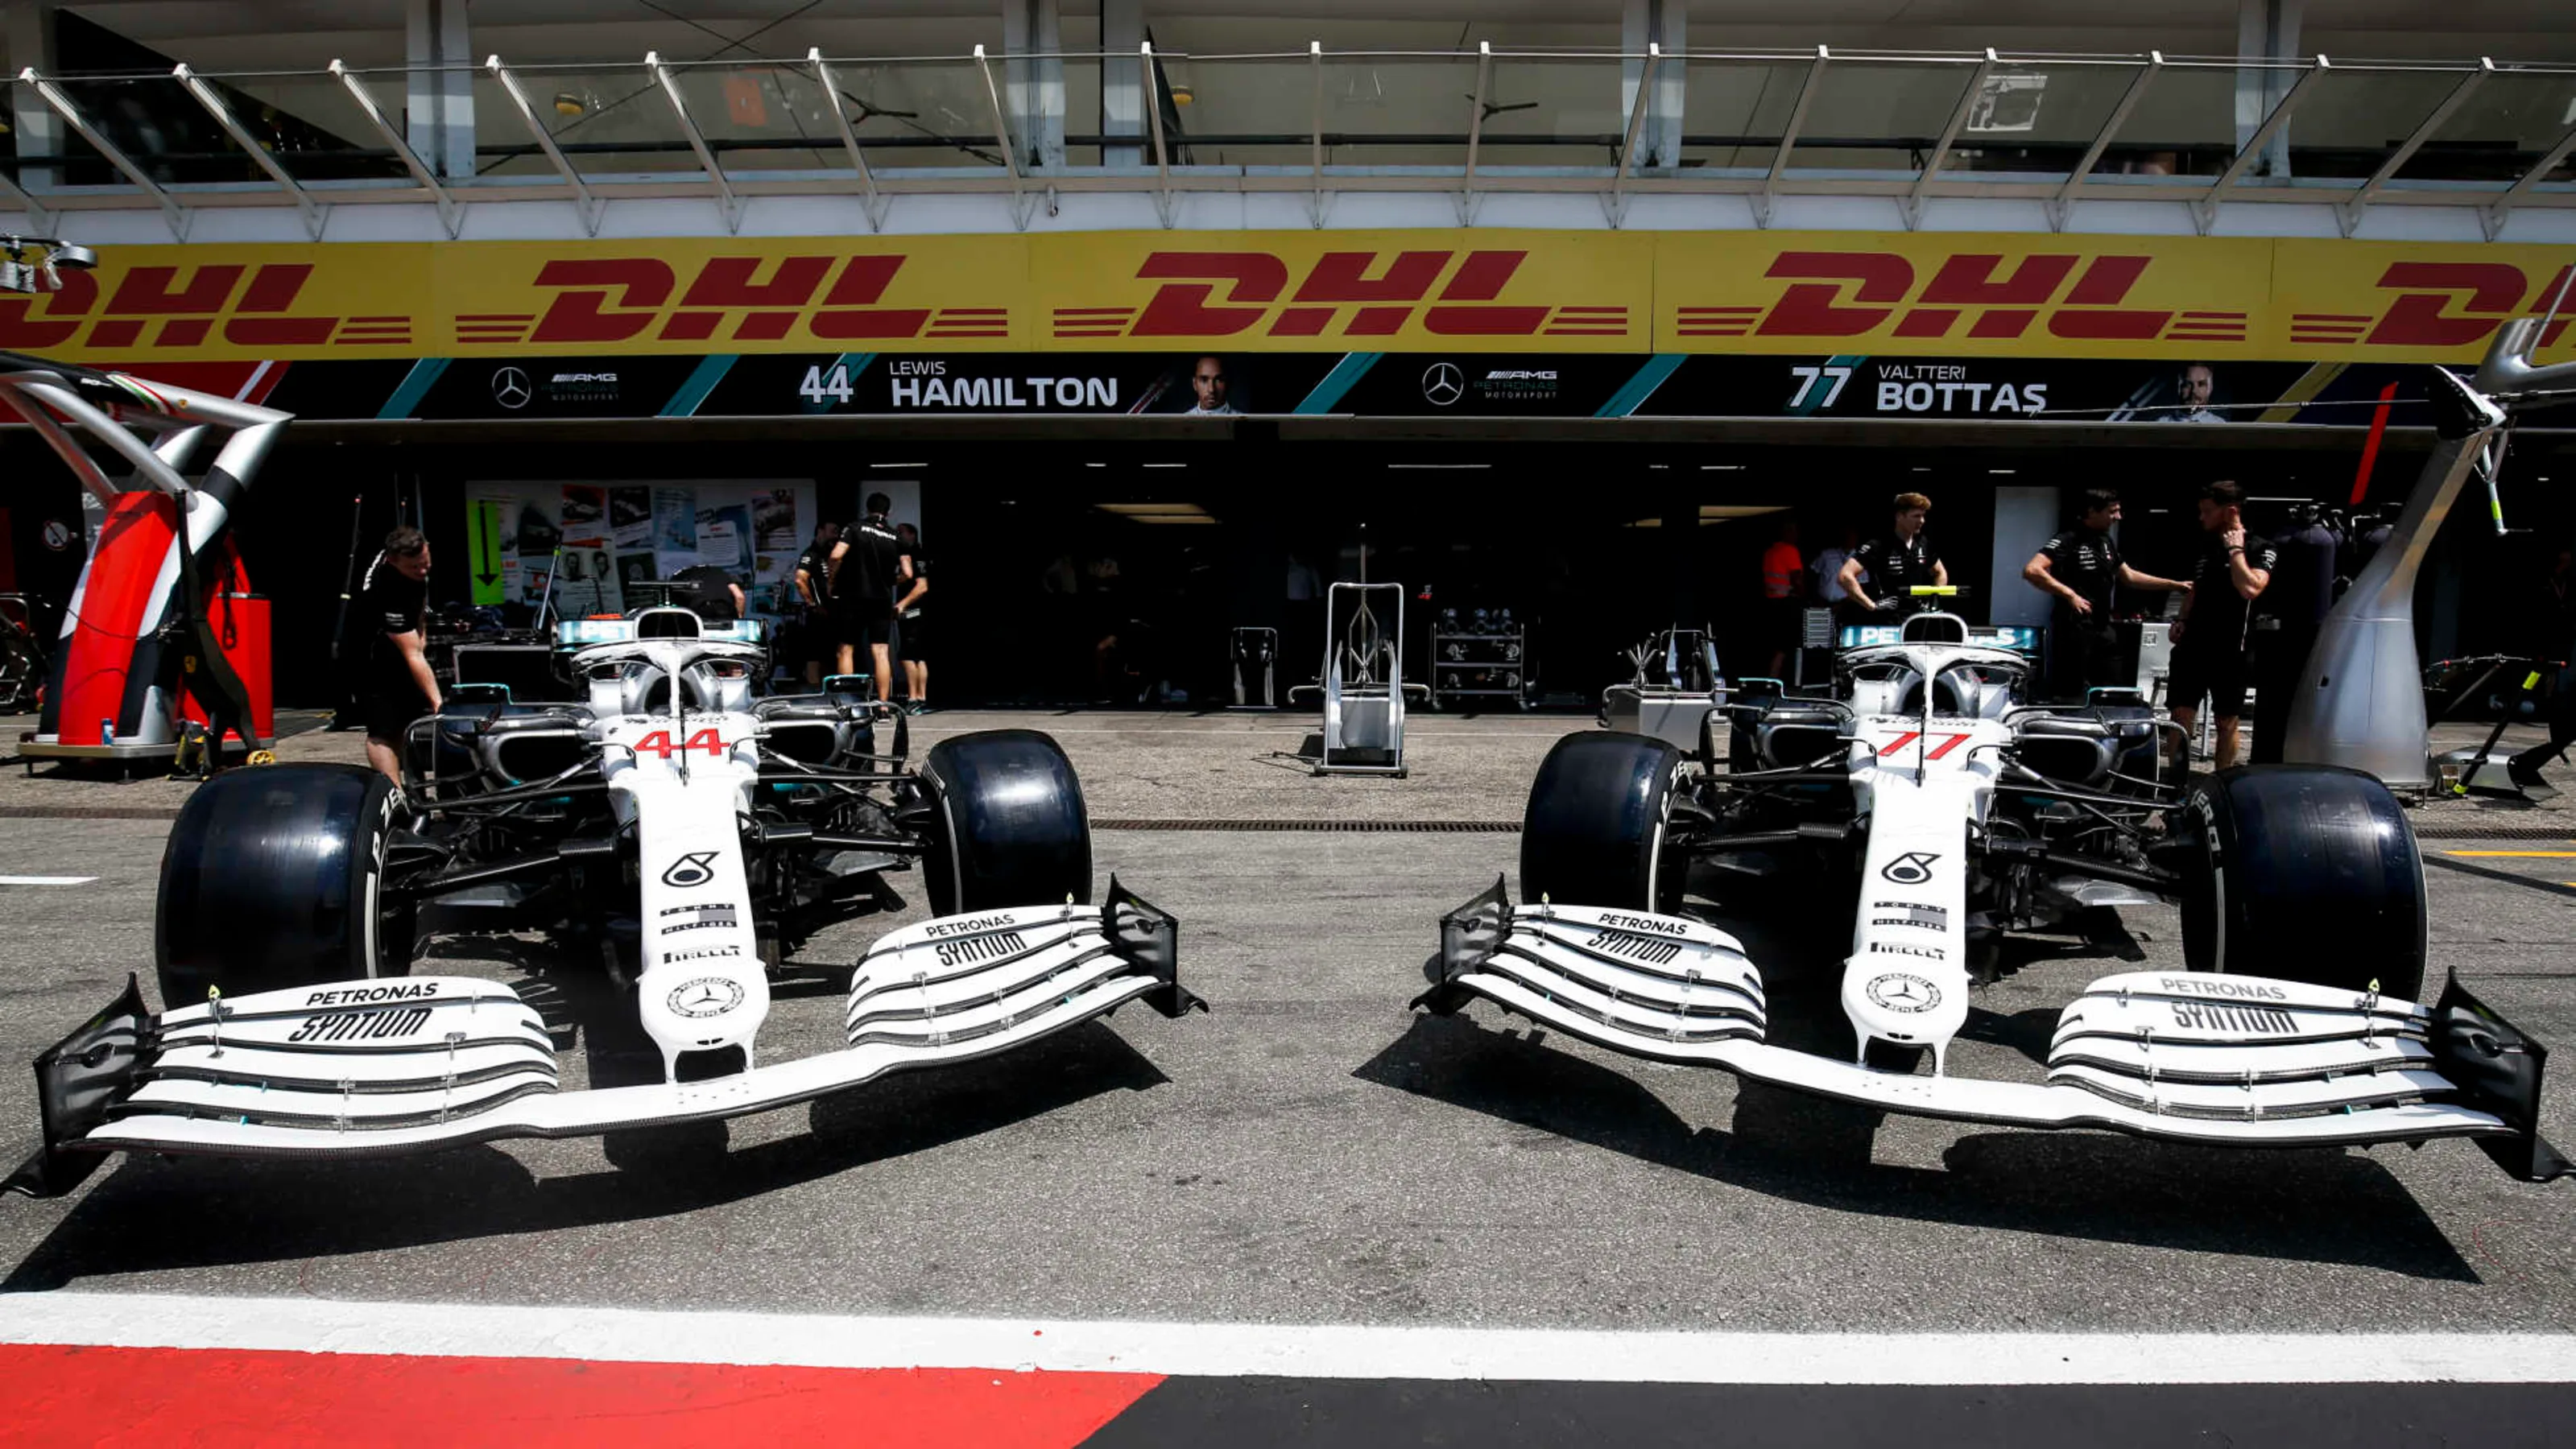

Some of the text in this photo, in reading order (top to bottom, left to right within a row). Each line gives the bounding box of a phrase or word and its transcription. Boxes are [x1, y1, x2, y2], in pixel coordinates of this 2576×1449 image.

[527, 254, 932, 342] DHL
[1128, 250, 1553, 336] DHL
[1755, 251, 2174, 339] DHL
[889, 361, 946, 376] LEWIS
[1878, 365, 1967, 379] VALTTERI
[799, 365, 854, 404] 44
[891, 377, 1118, 407] HAMILTON
[1791, 365, 1852, 408] 77
[1877, 382, 2046, 411] BOTTAS
[633, 728, 731, 759] 44
[1877, 731, 1971, 759] 77
[925, 914, 1015, 939] PETRONAS
[1598, 912, 1689, 935] PETRONAS
[935, 931, 1028, 967] SYNTIUM
[1586, 928, 1683, 965] SYNTIUM
[306, 982, 440, 1007] PETRONAS
[2160, 977, 2288, 1001] PETRONAS
[288, 1008, 432, 1042] SYNTIUM
[2171, 1001, 2301, 1034] SYNTIUM
